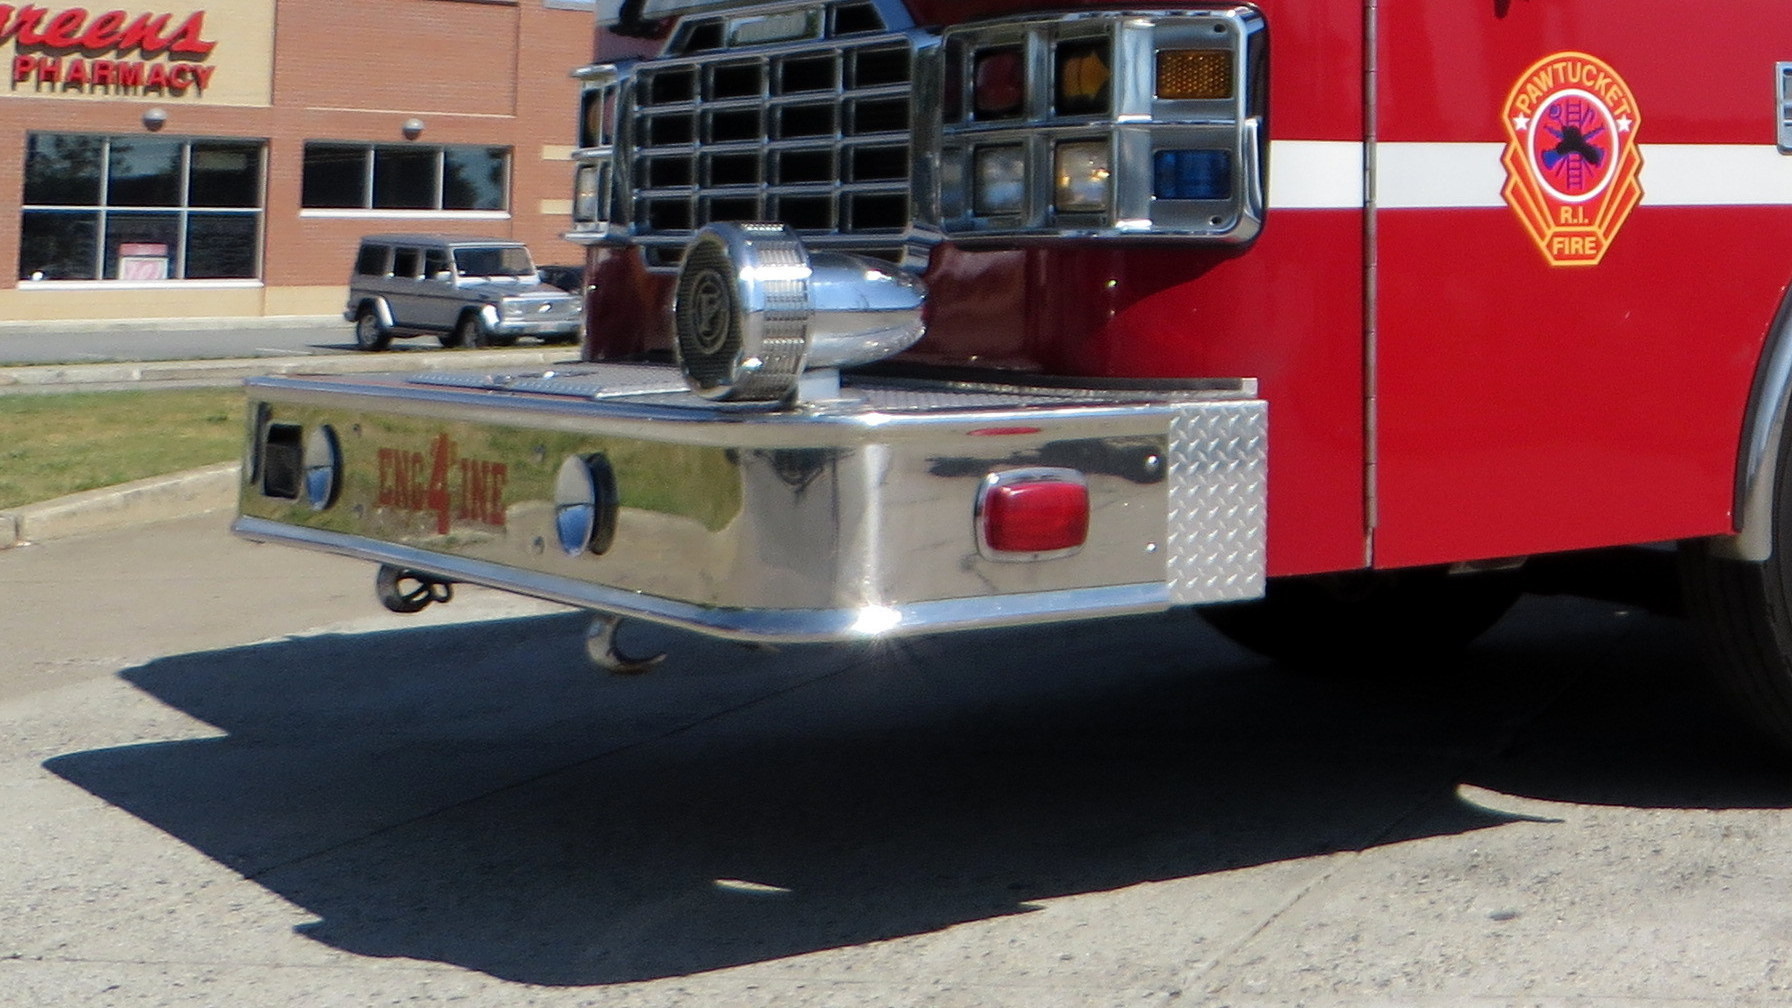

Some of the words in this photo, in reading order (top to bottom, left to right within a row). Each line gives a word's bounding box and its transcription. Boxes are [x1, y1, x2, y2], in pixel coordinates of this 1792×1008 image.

[14, 55, 215, 90] PHARMACY
[1515, 61, 1632, 115] PAWTUCKET
[1560, 205, 1590, 224] R.I.
[1552, 236, 1599, 255] FIRE
